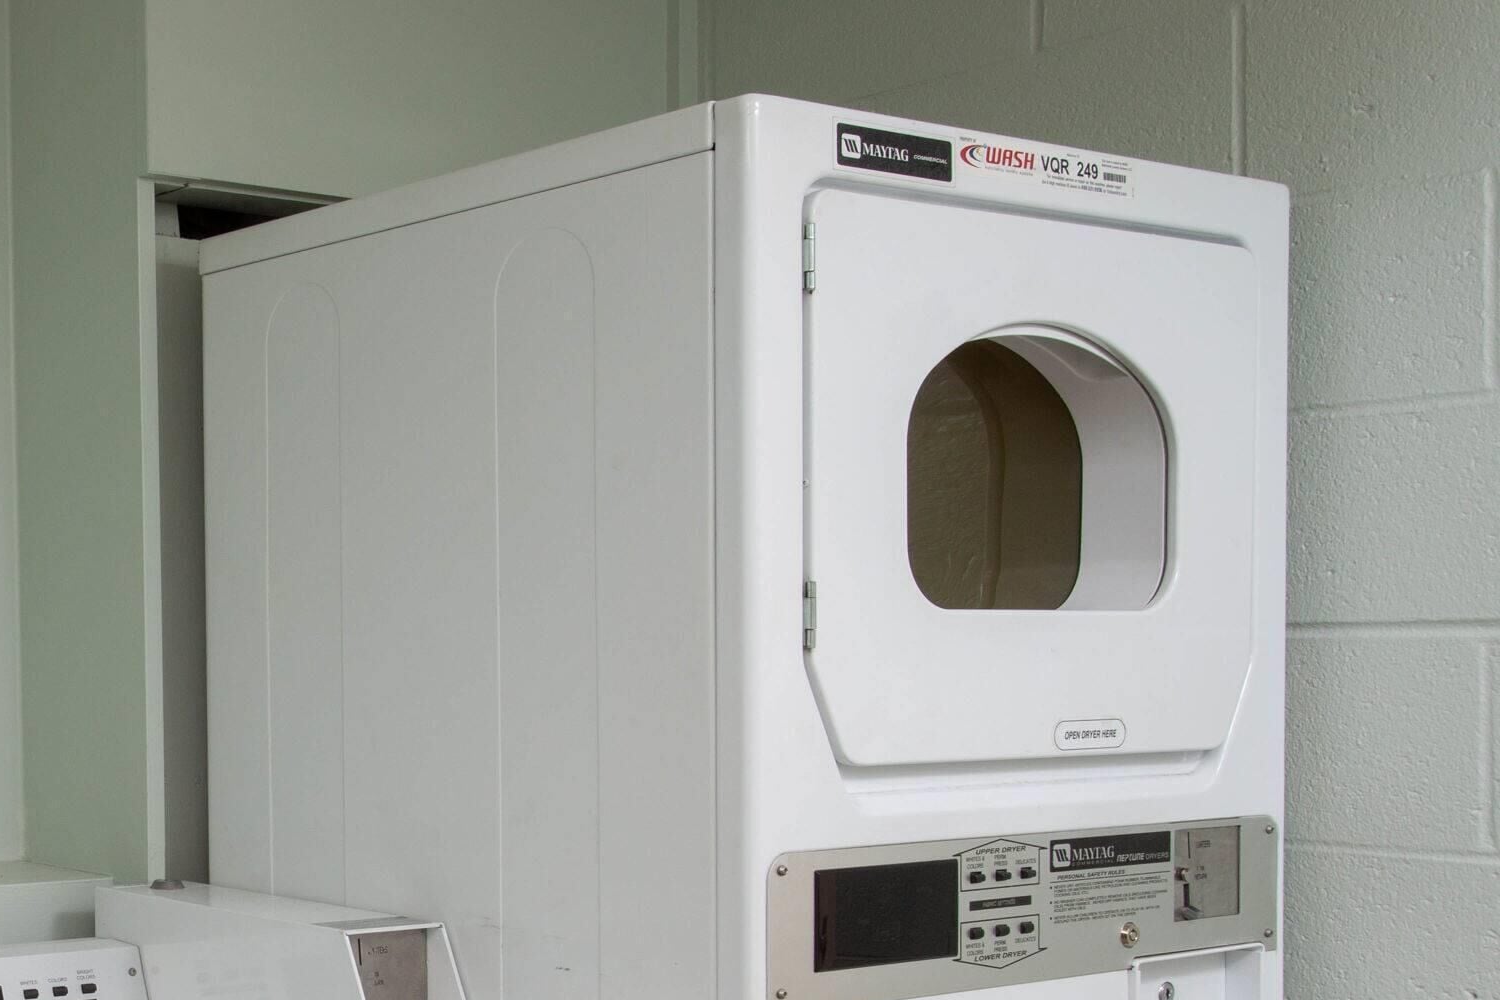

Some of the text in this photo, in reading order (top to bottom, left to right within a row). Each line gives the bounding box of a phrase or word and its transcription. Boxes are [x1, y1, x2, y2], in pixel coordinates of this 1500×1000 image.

[862, 142, 948, 165] MAYTAG COMMERCIAL
[986, 146, 1035, 170] WASH
[1041, 155, 1070, 175] VQR
[1076, 161, 1099, 180] 249
[1064, 729, 1117, 740] OPEN DRYER HERE
[975, 845, 1027, 855] UPPER DRYER
[1072, 845, 1115, 861] MAYTAG
[1145, 851, 1169, 860] DRYERS
[974, 950, 1028, 962] LOWER DRYER
